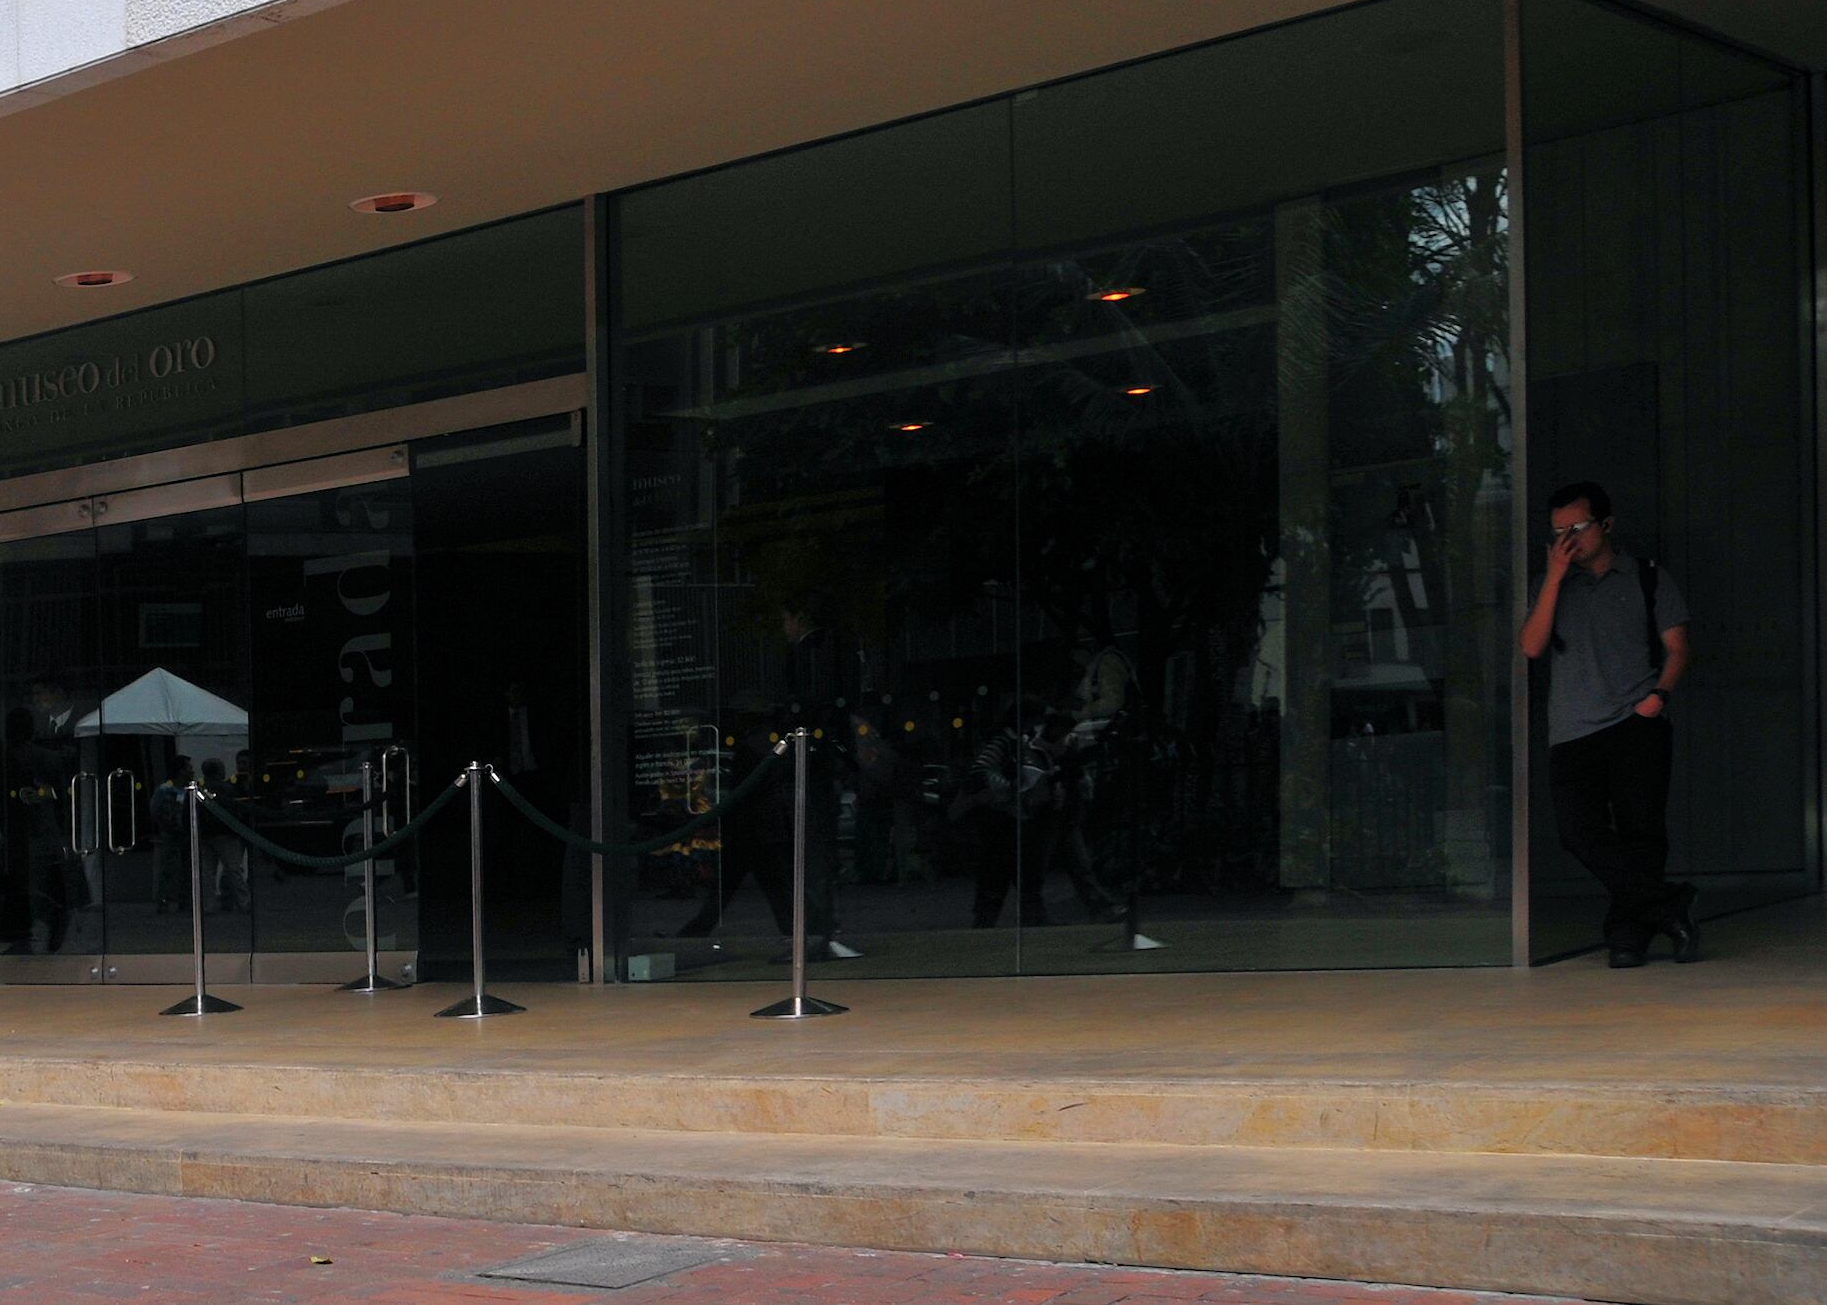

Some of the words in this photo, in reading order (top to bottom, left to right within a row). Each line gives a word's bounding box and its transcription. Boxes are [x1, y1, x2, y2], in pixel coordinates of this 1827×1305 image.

[107, 353, 139, 389] del
[148, 337, 216, 378] oro
[265, 601, 305, 619] entrada
